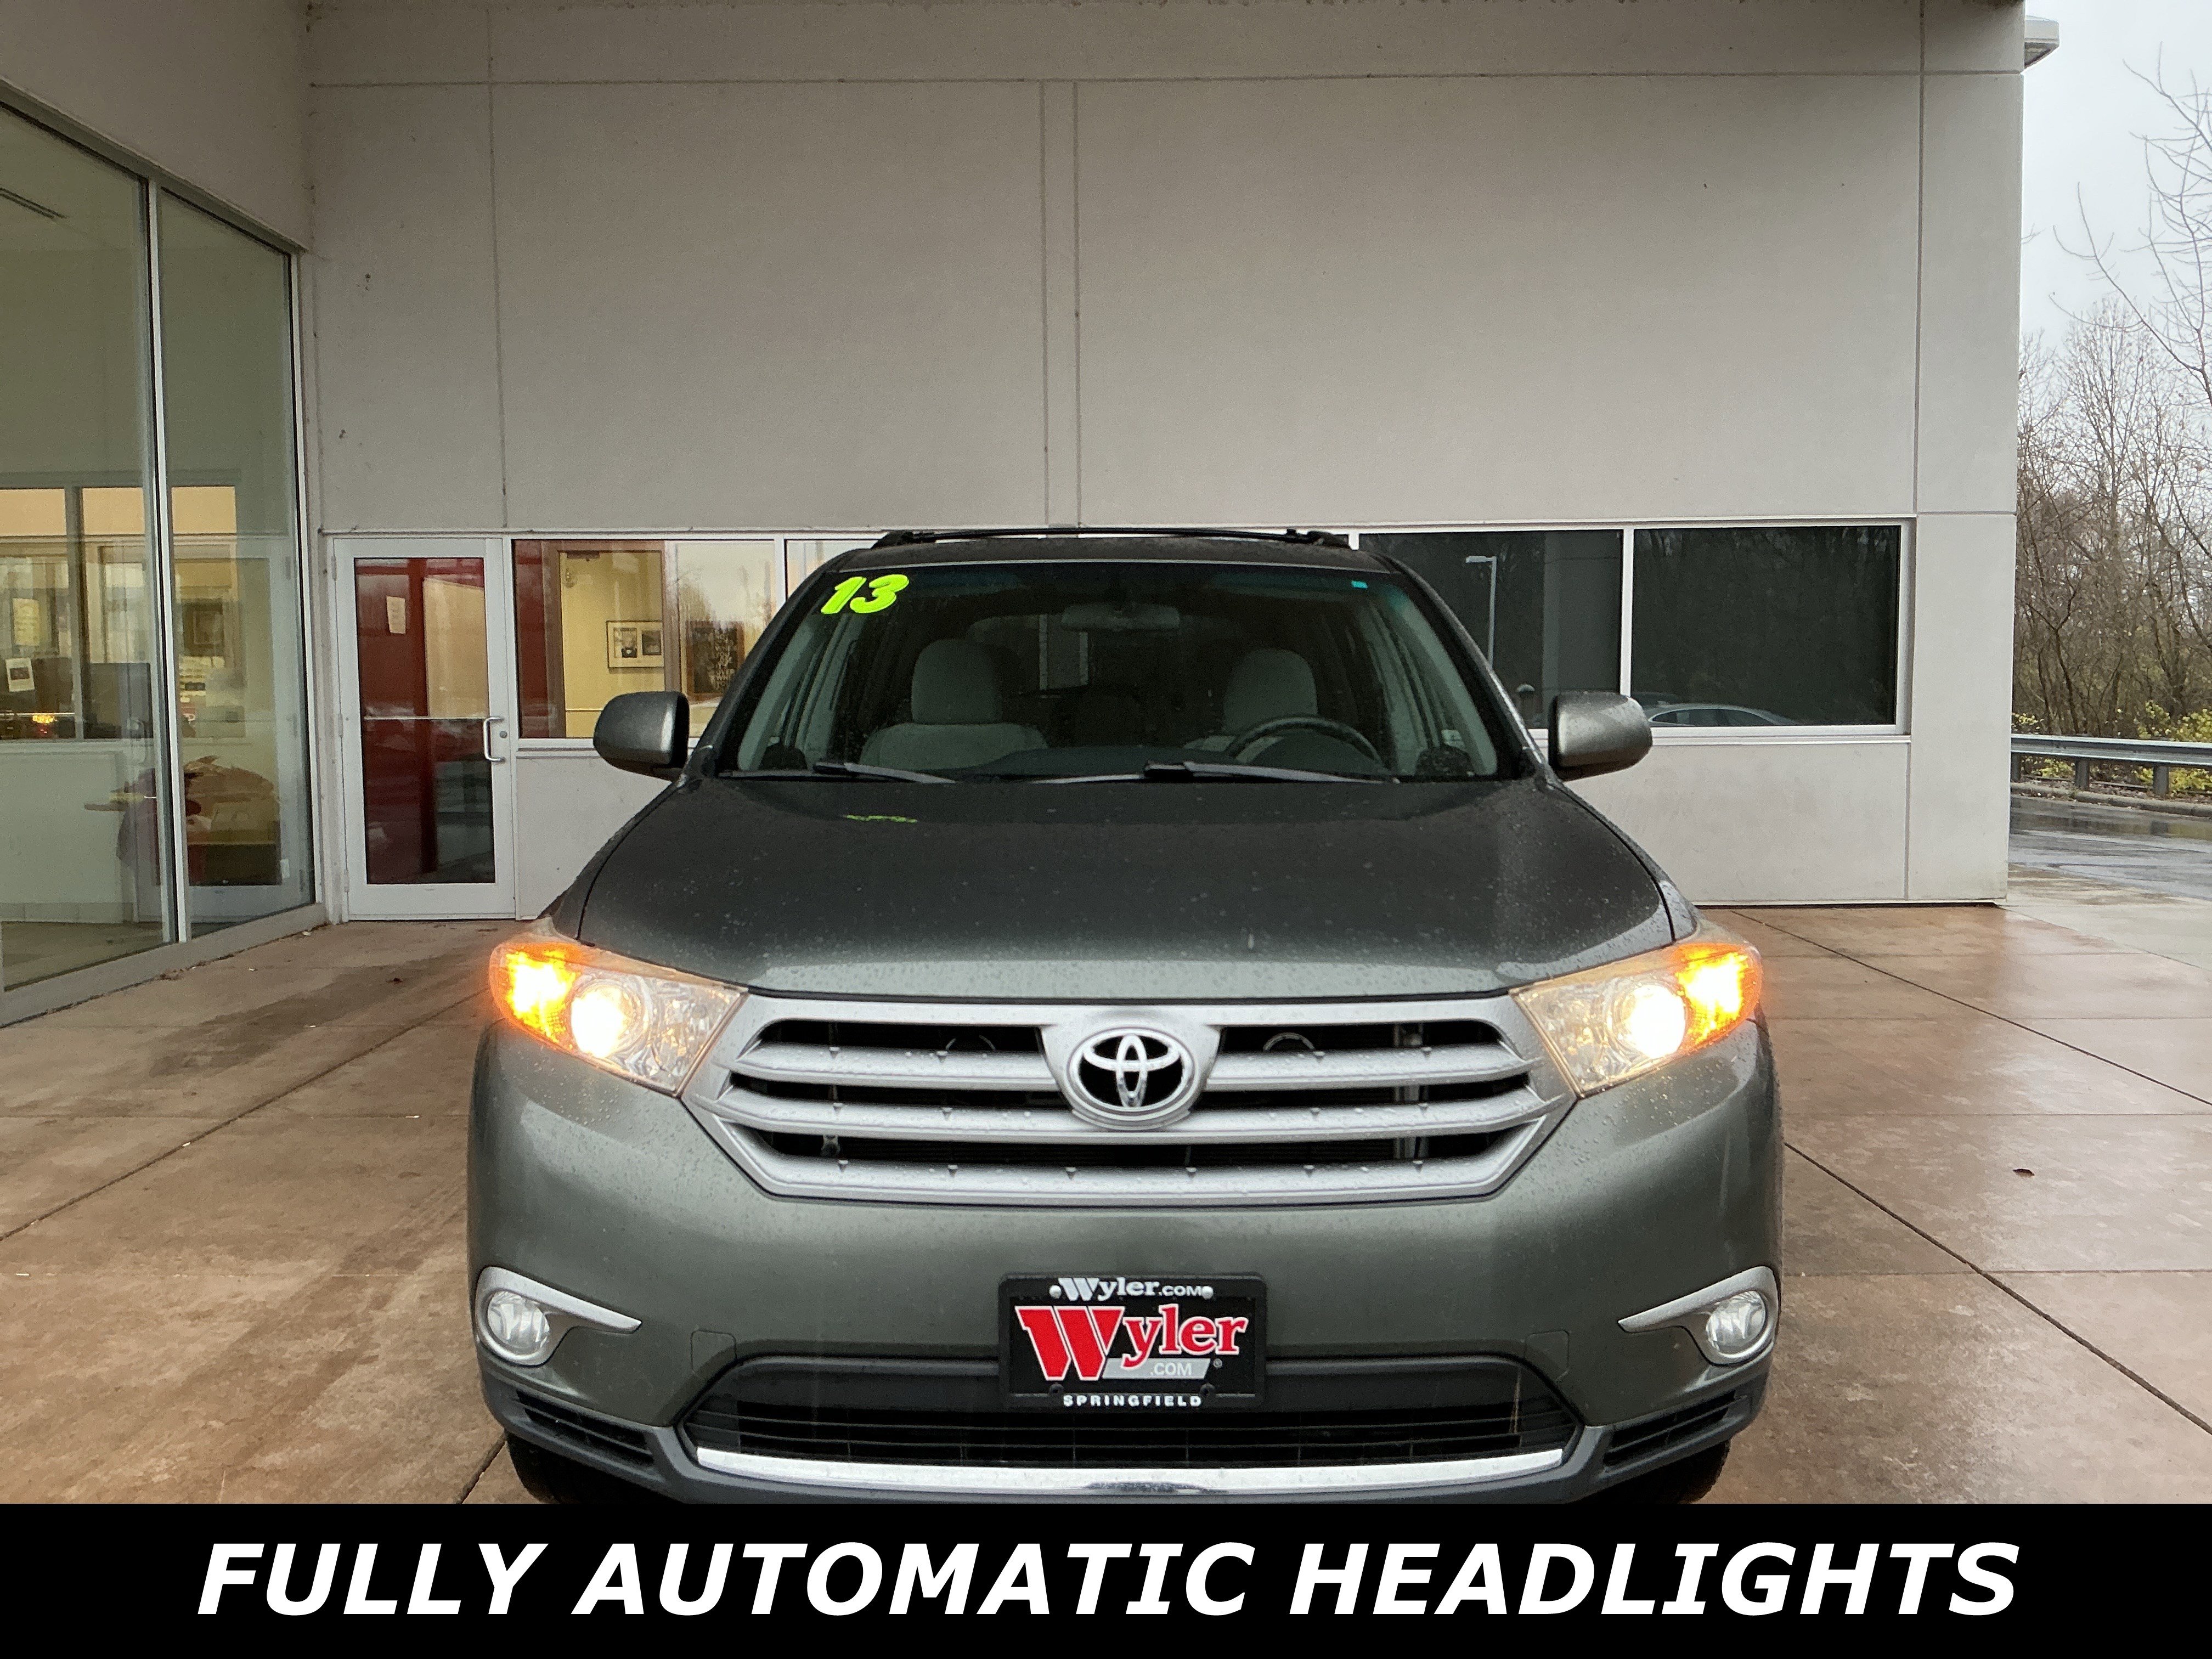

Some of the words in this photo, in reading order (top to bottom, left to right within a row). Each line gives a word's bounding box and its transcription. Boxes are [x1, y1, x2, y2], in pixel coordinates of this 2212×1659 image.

[821, 574, 910, 614] 13
[1015, 1304, 1248, 1381] Wyler
[1063, 1395, 1202, 1407] SPRINGFIELD
